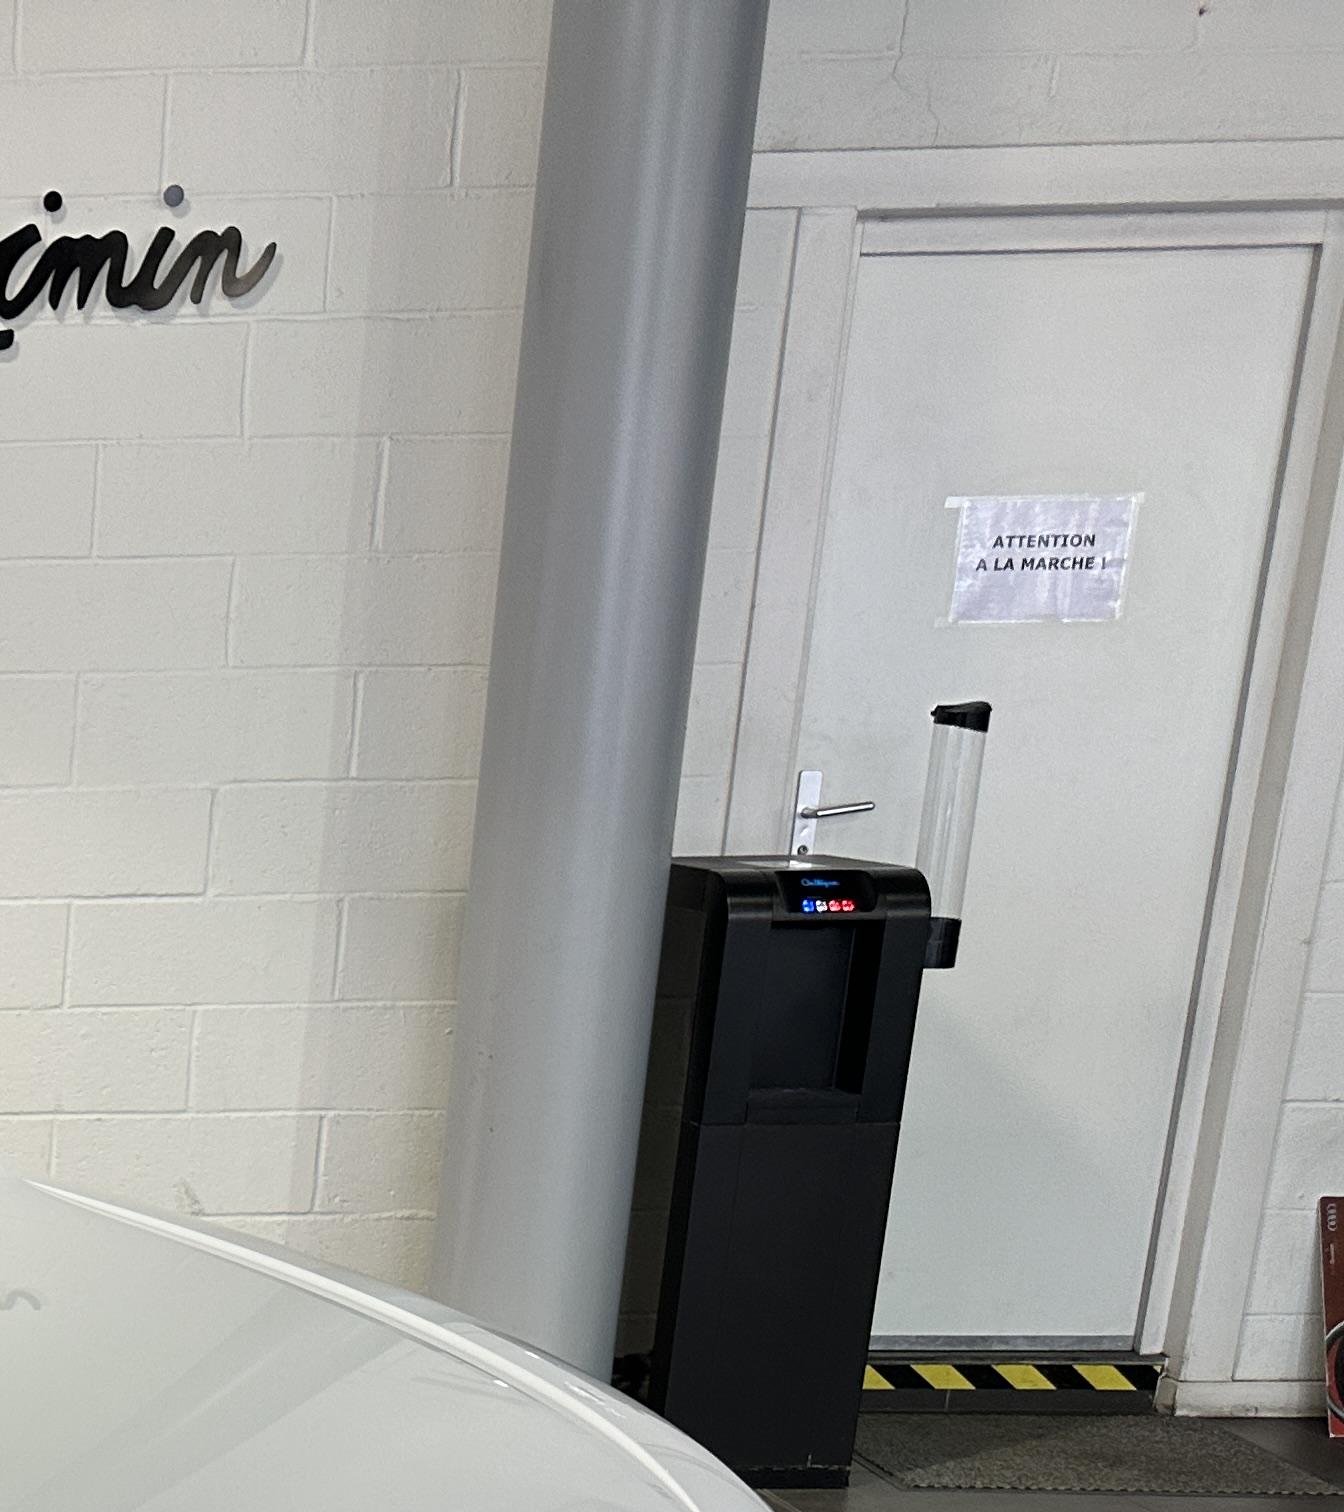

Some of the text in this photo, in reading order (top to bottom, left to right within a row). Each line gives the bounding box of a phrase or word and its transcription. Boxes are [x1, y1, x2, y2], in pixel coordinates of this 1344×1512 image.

[991, 533, 1096, 549] ATTENTION
[975, 558, 988, 571] A
[993, 557, 1015, 571] LA
[1020, 556, 1096, 571] MARCHE
